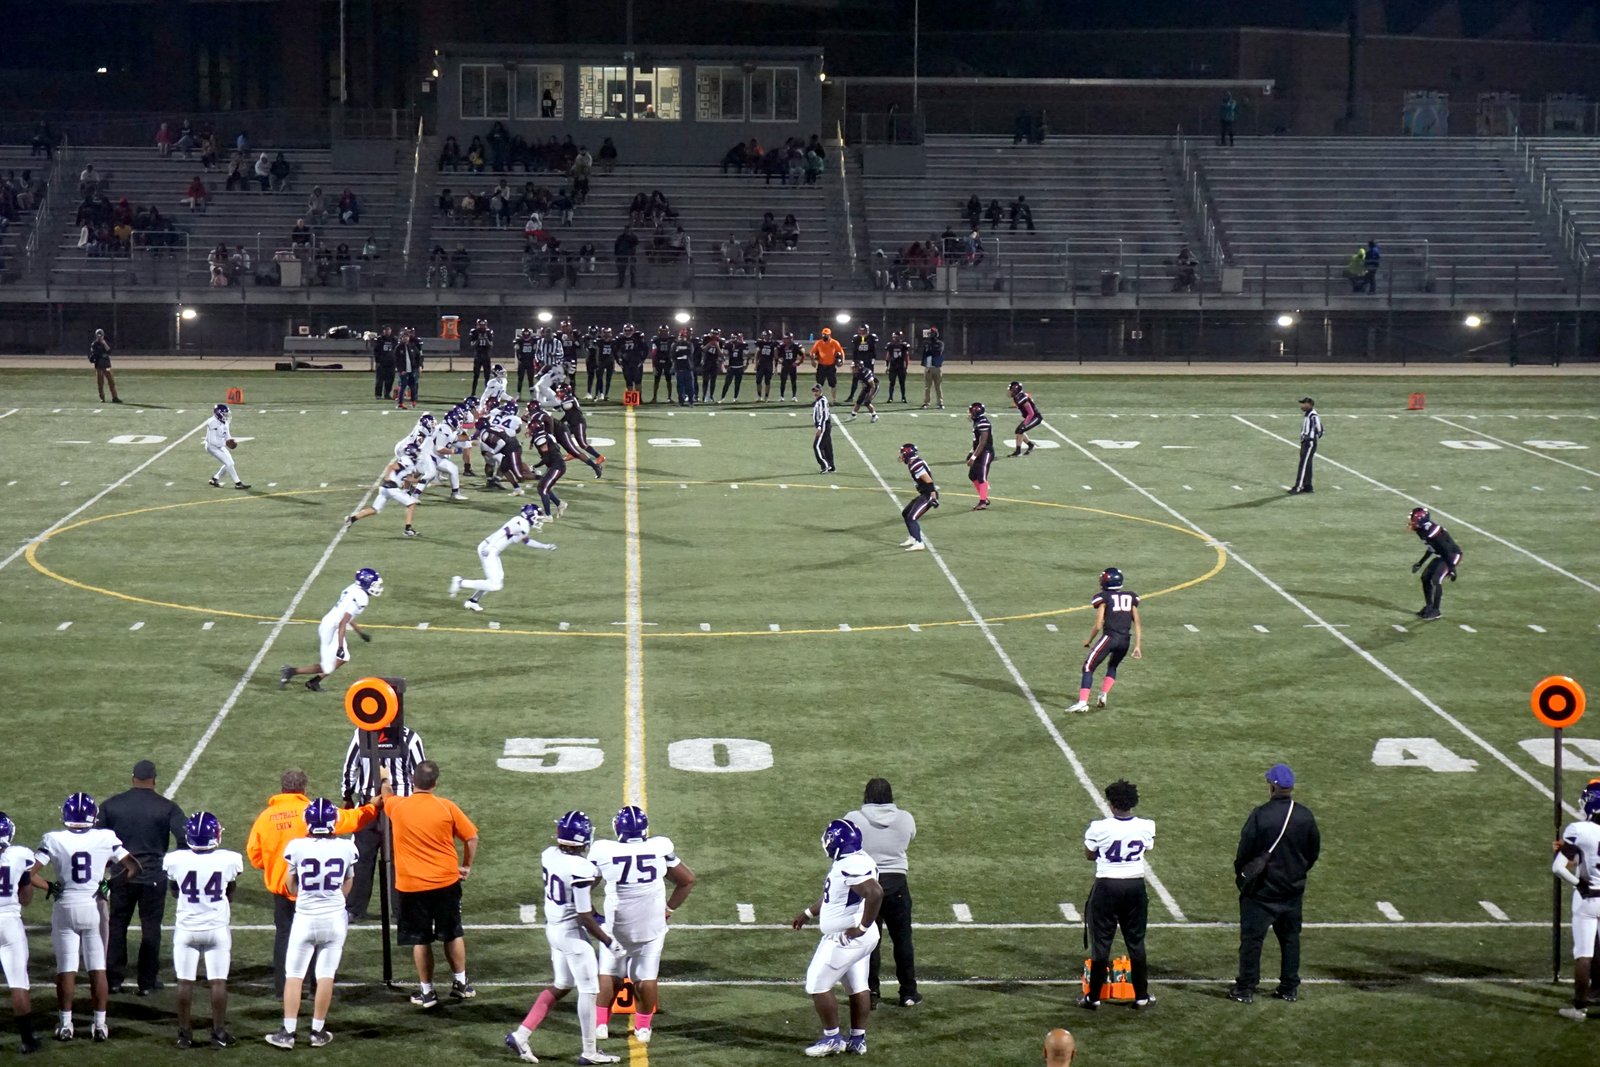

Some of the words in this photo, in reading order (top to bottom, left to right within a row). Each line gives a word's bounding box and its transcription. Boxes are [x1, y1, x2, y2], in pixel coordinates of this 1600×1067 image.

[228, 390, 241, 401] 40
[625, 392, 637, 403] 50
[1111, 594, 1132, 611] 10
[276, 822, 292, 831] CREW
[1105, 840, 1144, 863] 42
[71, 851, 91, 883] 8
[301, 858, 344, 891] 22
[612, 854, 657, 884] 75
[181, 870, 223, 903] 44
